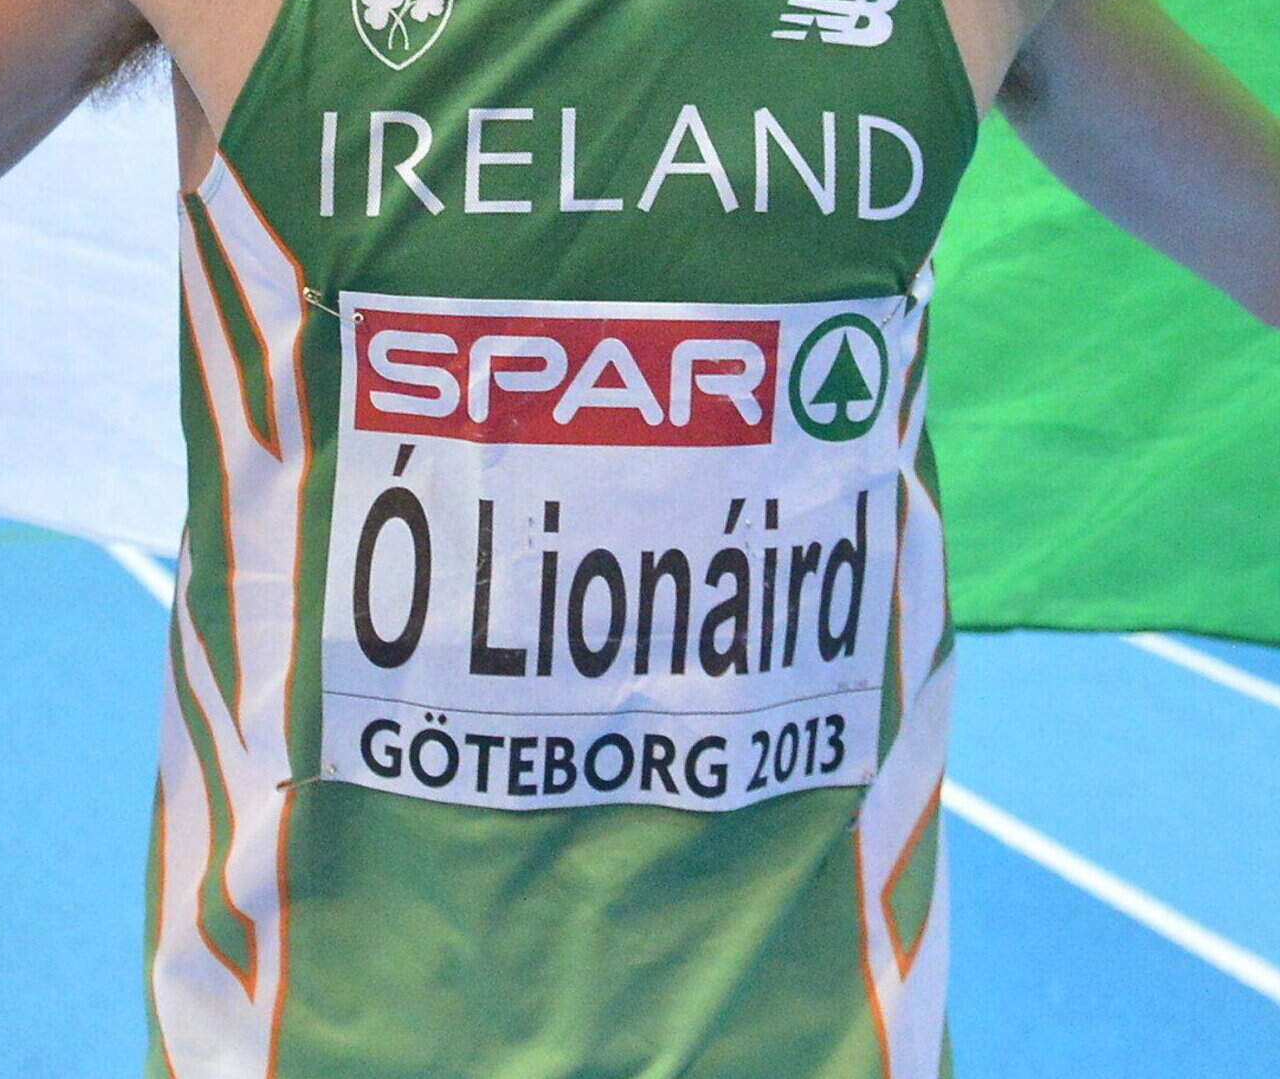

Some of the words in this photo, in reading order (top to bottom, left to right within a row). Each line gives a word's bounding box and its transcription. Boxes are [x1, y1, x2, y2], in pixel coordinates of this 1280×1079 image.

[319, 105, 925, 222] IRELAND
[367, 330, 765, 428] SPAR
[352, 444, 433, 670] Ó
[468, 489, 870, 679] Lionáird
[360, 711, 729, 799] GÖTEBORG
[746, 713, 847, 793] 2013
